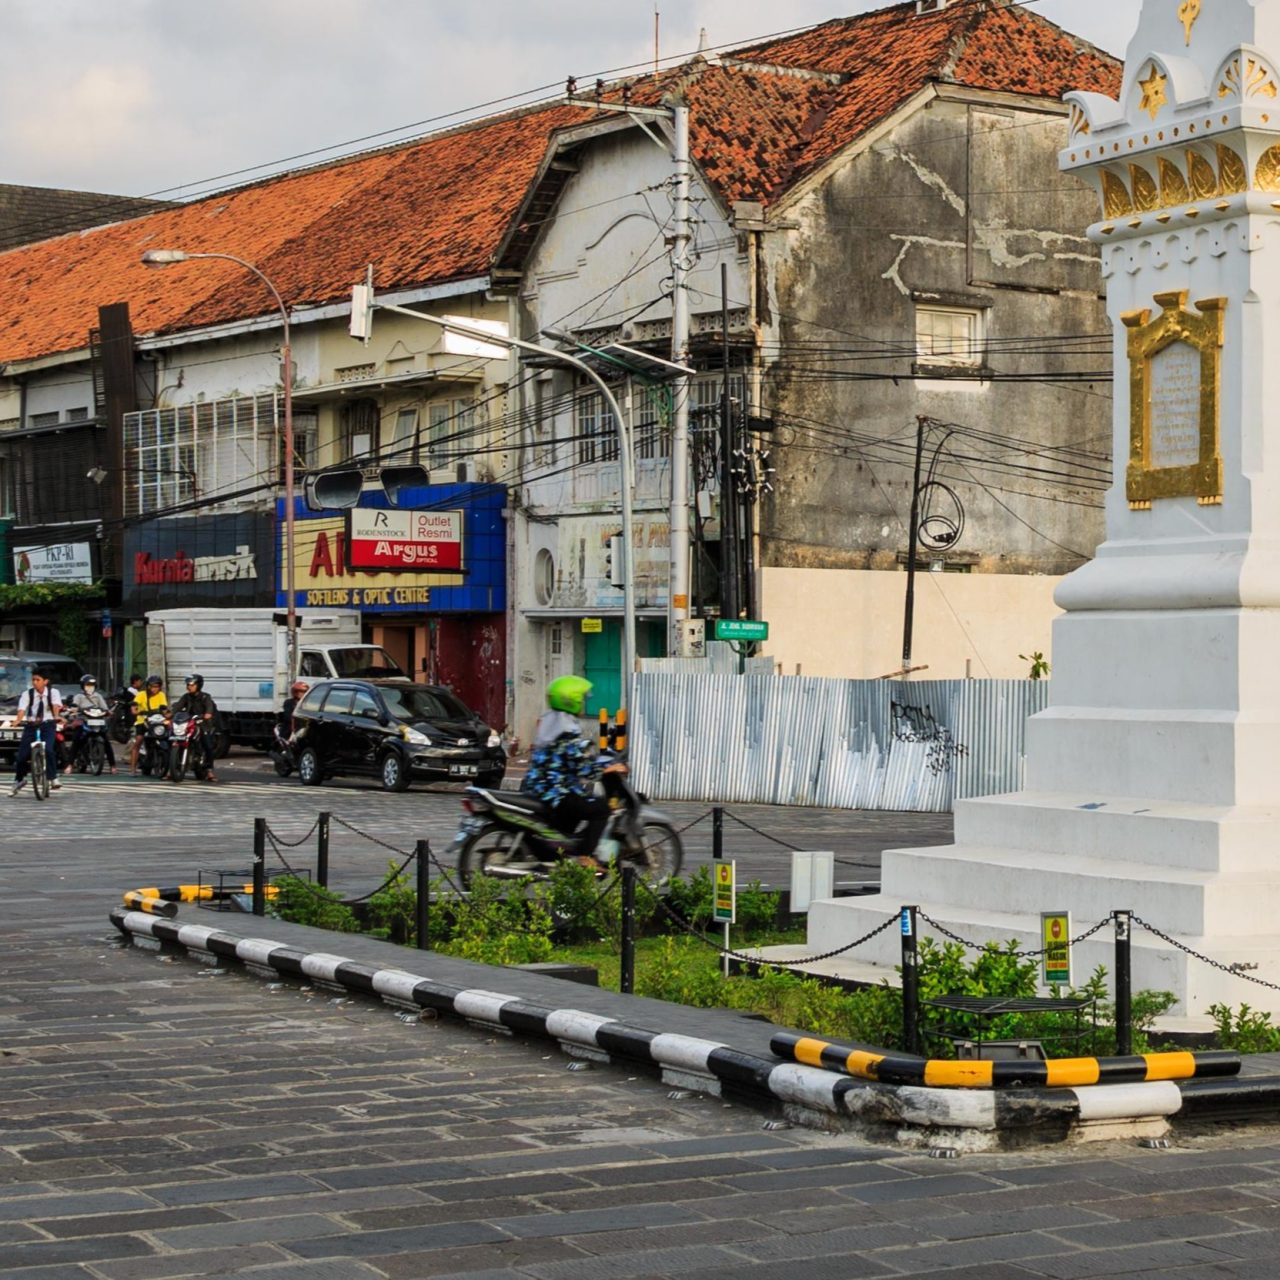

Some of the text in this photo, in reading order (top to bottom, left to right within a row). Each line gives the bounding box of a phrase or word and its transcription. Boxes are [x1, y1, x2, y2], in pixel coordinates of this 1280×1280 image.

[418, 515, 451, 526] Outlet
[357, 529, 407, 537] RODENSTOCK
[418, 528, 453, 538] Resmi
[374, 541, 438, 563] Argus
[134, 552, 193, 584] Kurnia
[307, 588, 429, 605] SOFTLENS & OPTIC CENTRE
